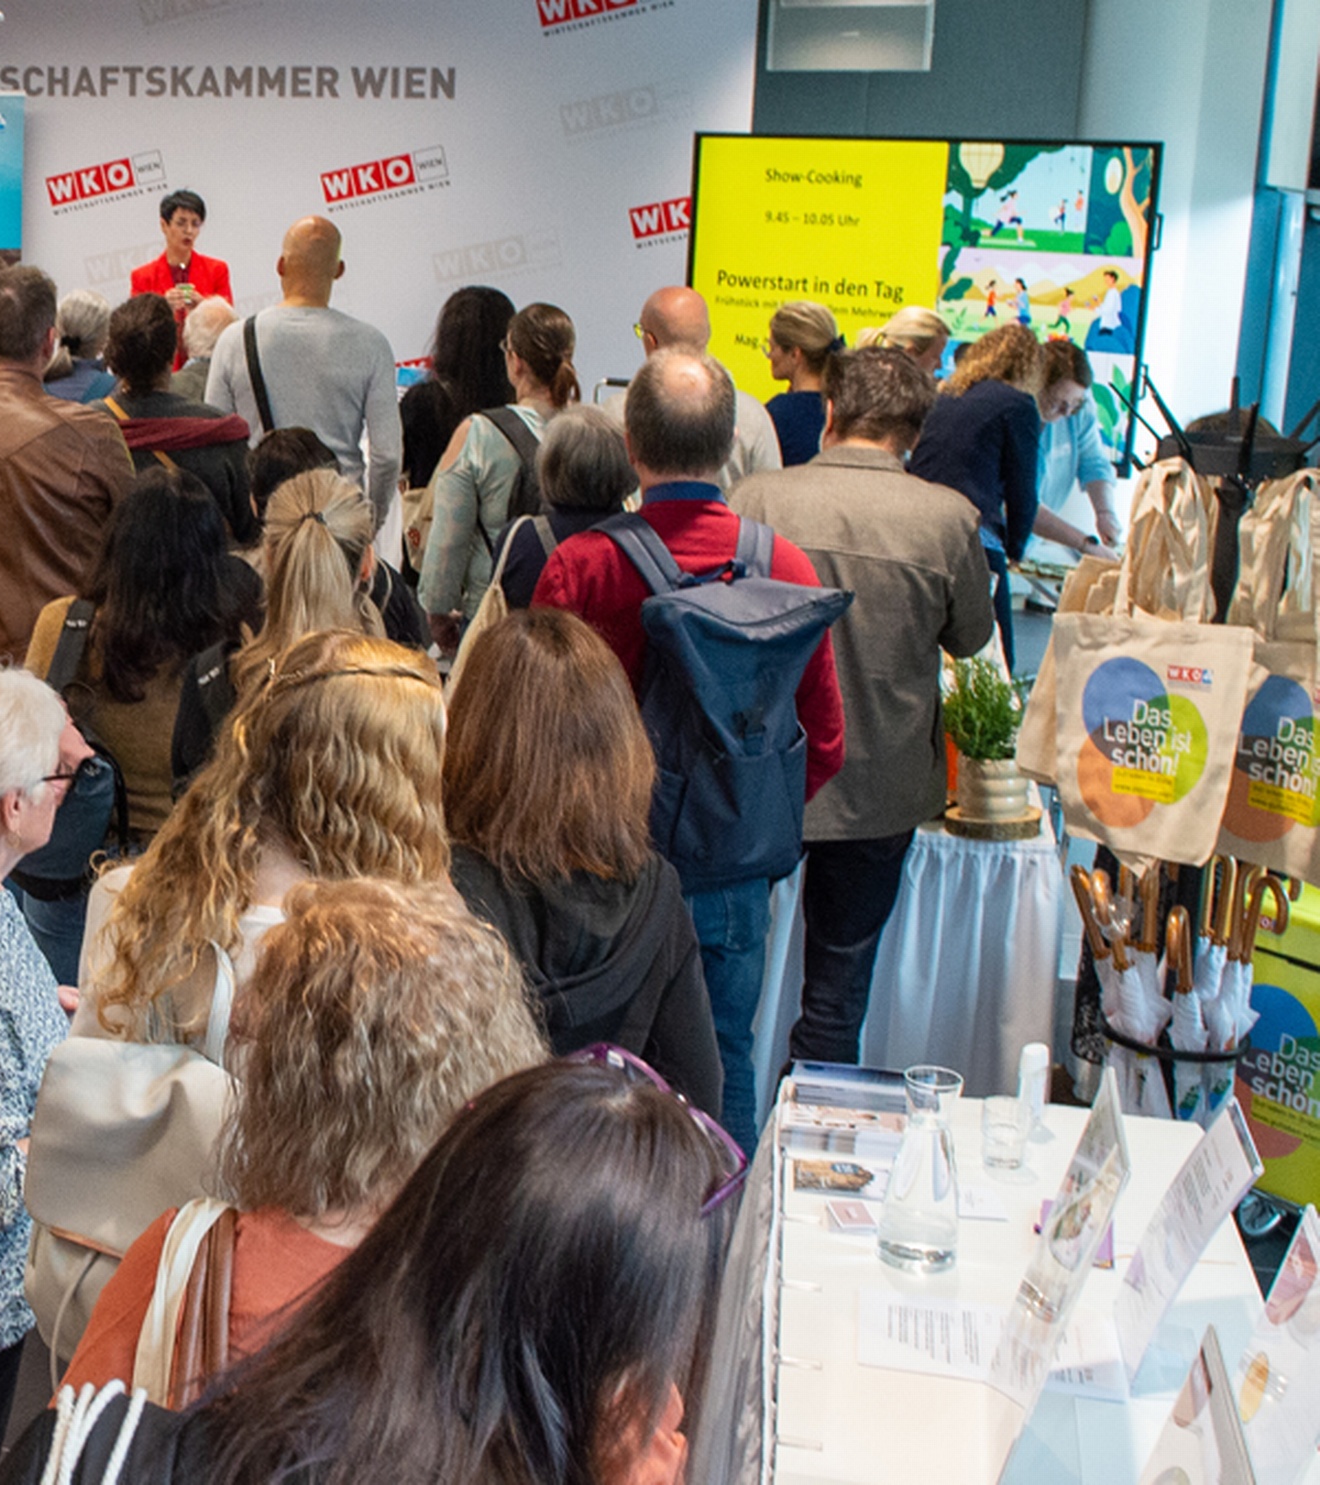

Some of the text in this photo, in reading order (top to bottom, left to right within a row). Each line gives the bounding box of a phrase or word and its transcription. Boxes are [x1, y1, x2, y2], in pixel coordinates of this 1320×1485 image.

[351, 66, 456, 98] WIEN
[48, 162, 131, 202] WKO
[322, 158, 411, 199] WKO
[765, 168, 863, 188] Show-Cooking
[632, 199, 690, 234] WK
[765, 211, 790, 224] 9.45
[803, 212, 835, 226] 10.05
[838, 213, 860, 227] Uhr
[717, 269, 904, 303] Powerstart in den Tag
[1168, 668, 1202, 683] WKO
[1133, 698, 1173, 728] Das
[1103, 715, 1192, 755] Leben ist
[1237, 730, 1310, 770] Leben
[1277, 716, 1317, 755] Das
[1111, 745, 1180, 777] schön!
[1248, 761, 1317, 800] schön!
[1279, 1032, 1320, 1071] Das
